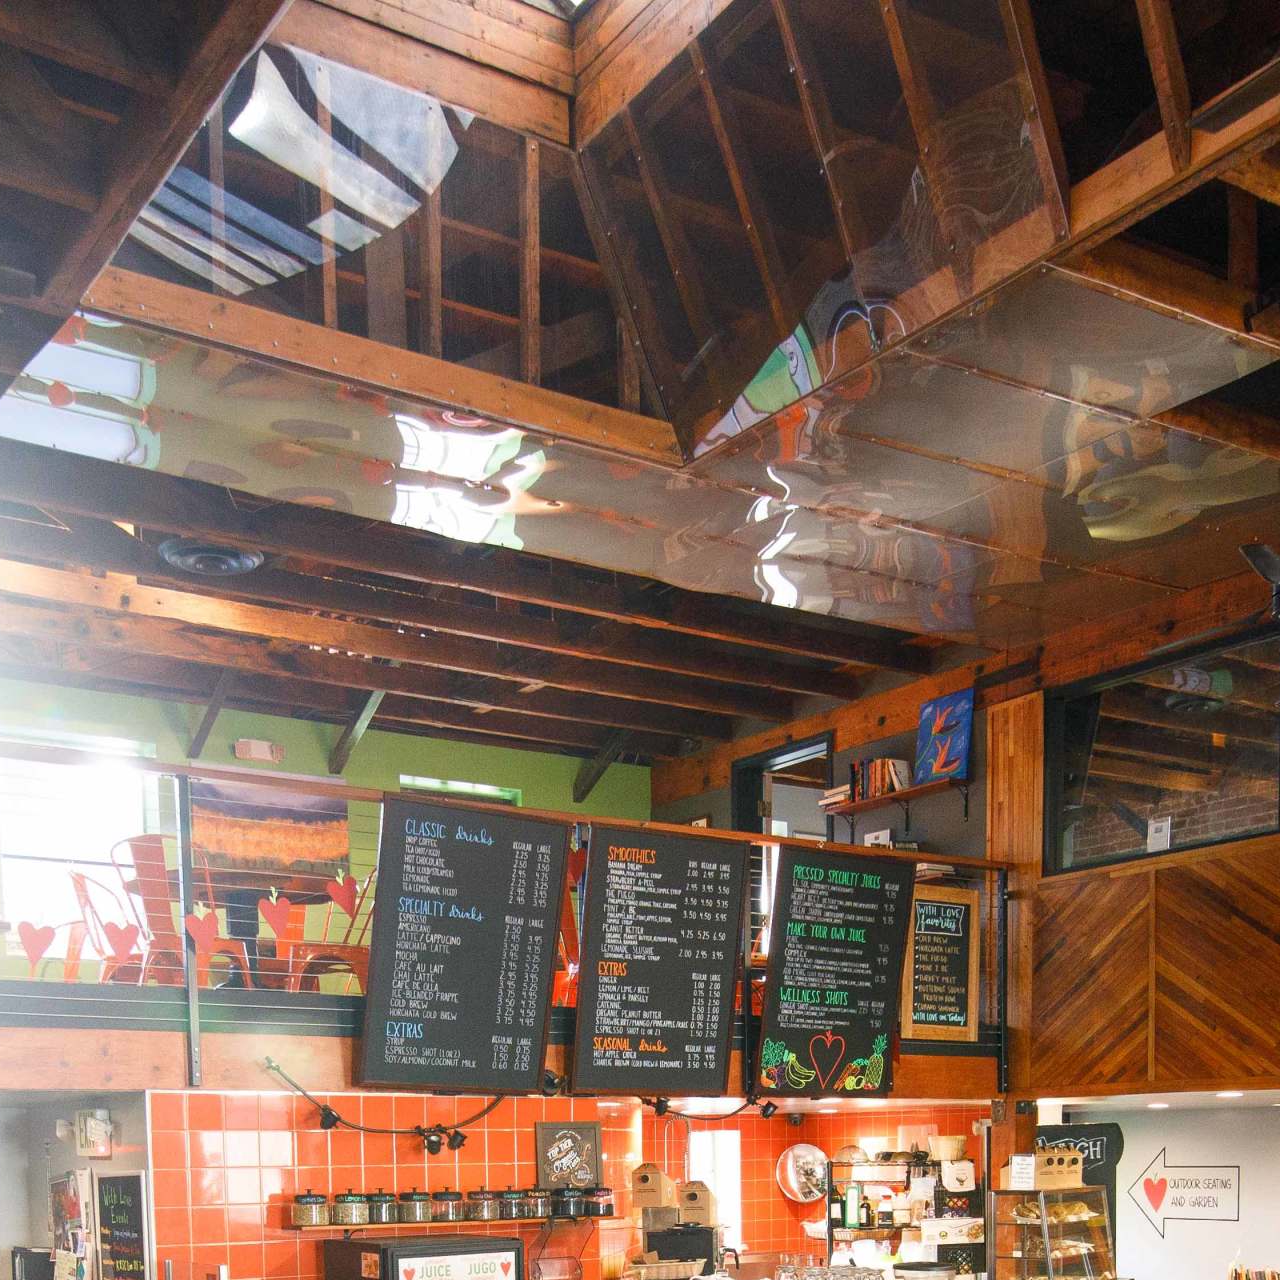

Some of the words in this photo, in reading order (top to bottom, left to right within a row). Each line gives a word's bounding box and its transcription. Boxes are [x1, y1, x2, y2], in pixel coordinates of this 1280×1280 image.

[405, 819, 446, 838] CLASSIC
[455, 825, 496, 845] drinks
[608, 846, 656, 863] SMOOTHIES
[793, 865, 824, 882] PRESSED
[827, 869, 860, 887] SPECIALTY
[861, 873, 881, 889] JUICES
[398, 896, 446, 917] SPECIALTY
[449, 902, 484, 921] drinks
[918, 905, 937, 916] WITH
[941, 907, 960, 919] LOVE
[787, 922, 807, 937] MAKE
[811, 924, 828, 939] YOUR
[830, 926, 845, 940] OWN
[847, 928, 866, 943] JUICE
[430, 943, 450, 954] LATTE
[395, 951, 418, 961] MOCHA
[430, 964, 444, 974] LAIT
[598, 961, 627, 976] EXTRAS
[414, 972, 434, 982] LATTE
[780, 987, 820, 1003] WELLNESS
[825, 991, 849, 1006] SHOTS
[390, 999, 406, 1008] COLD
[409, 1000, 428, 1009] BREW
[386, 1021, 423, 1038] EXTRAS
[385, 1046, 417, 1056] ESPRESSO
[593, 1037, 632, 1051] SEASONAL
[1169, 1178, 1200, 1189] OUTDOOR
[1202, 1178, 1232, 1189] SEATING
[1171, 1196, 1186, 1207] AND
[1189, 1196, 1218, 1208] GARDEN
[419, 1265, 452, 1279] JUICE
[468, 1262, 497, 1276] JUGO
